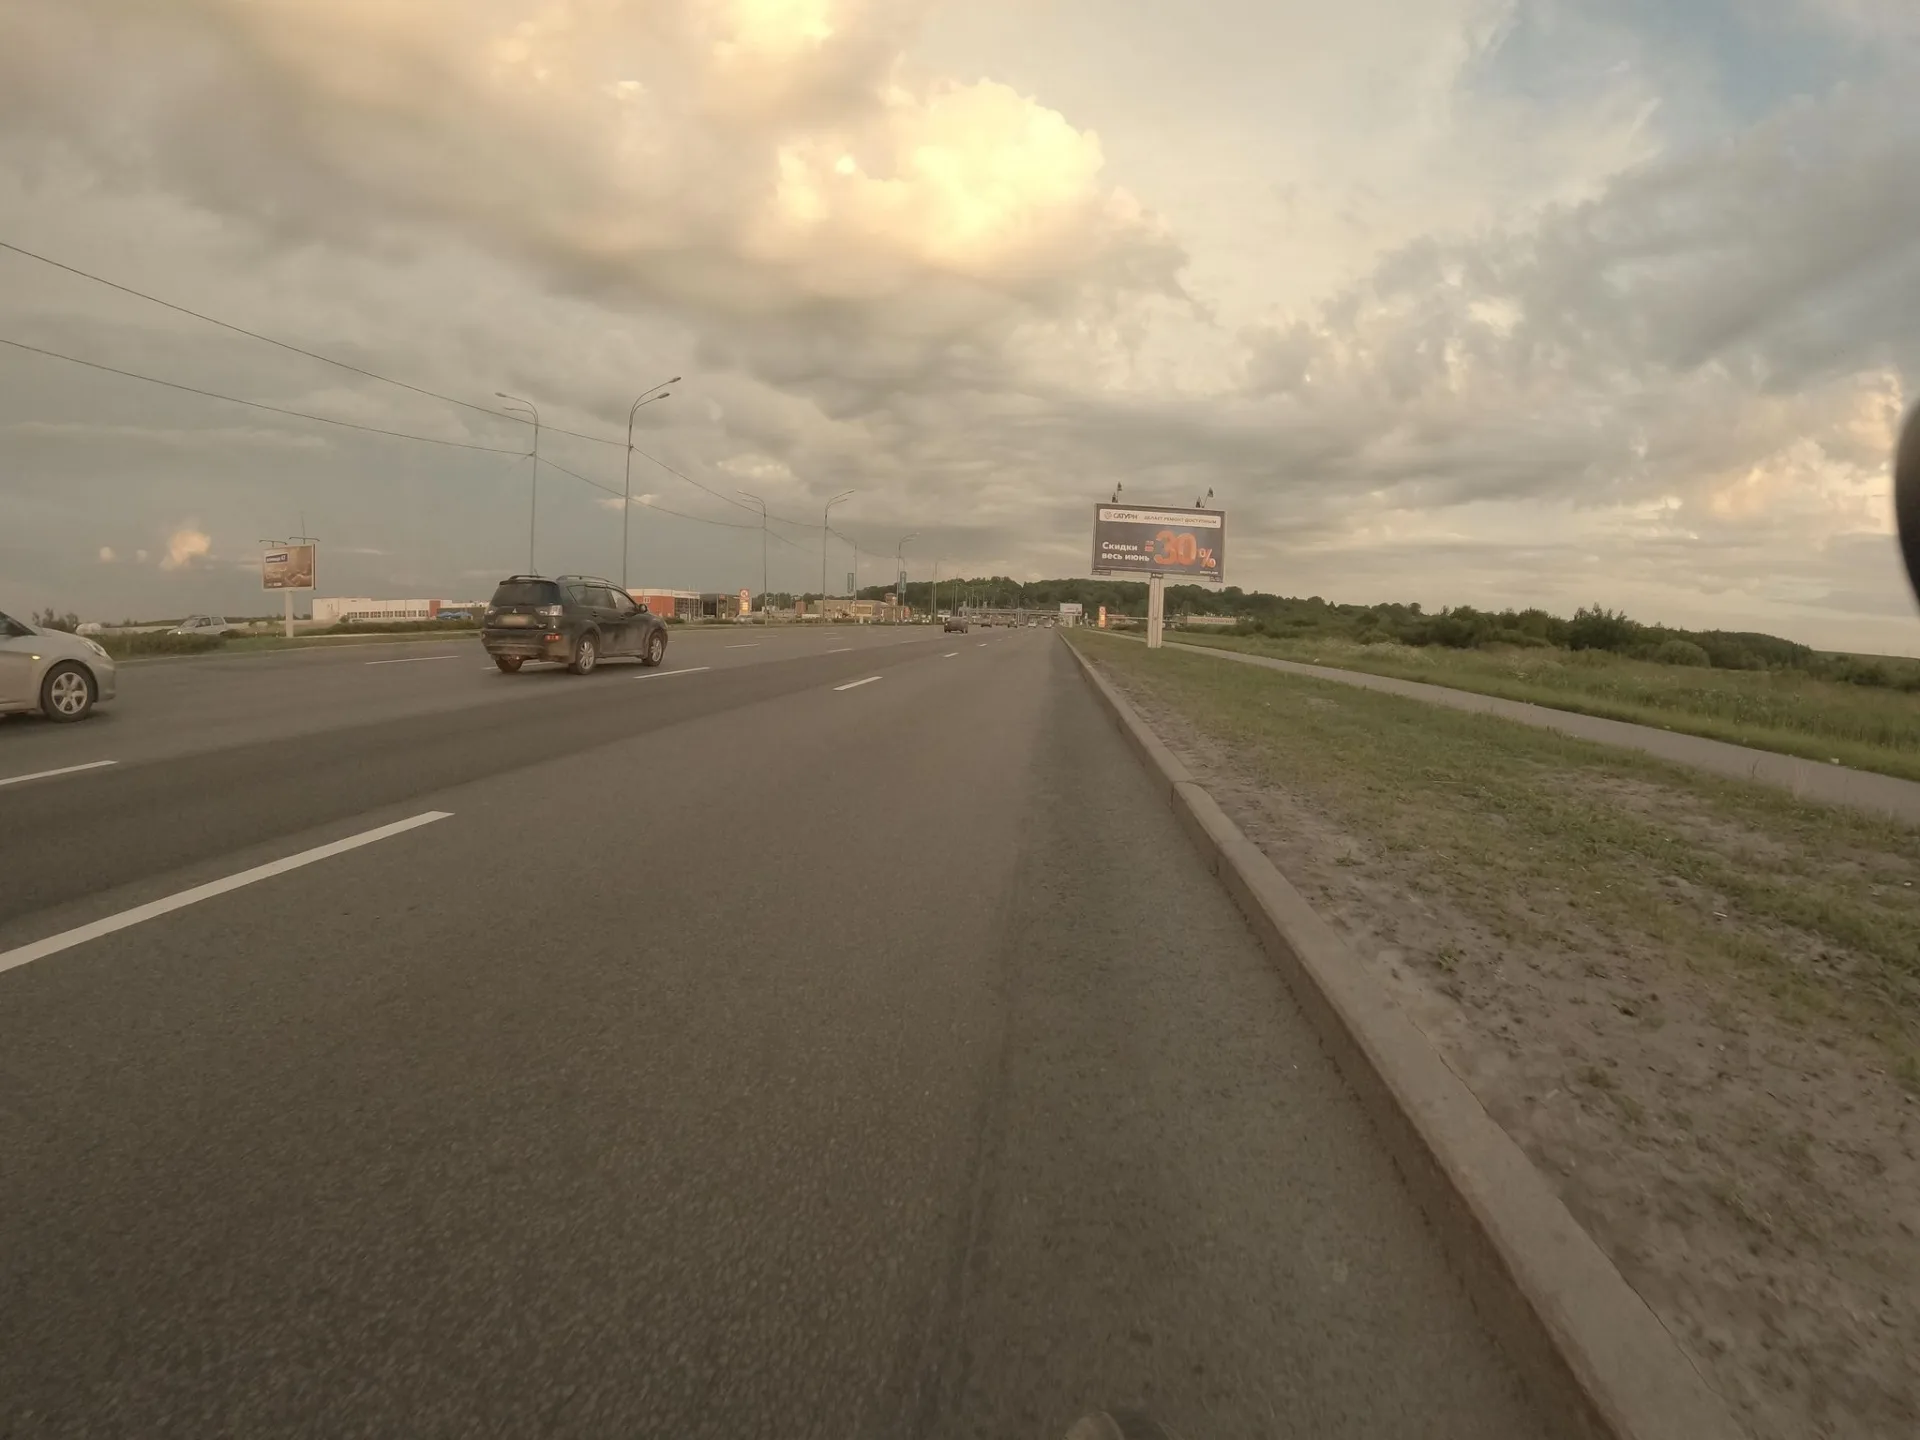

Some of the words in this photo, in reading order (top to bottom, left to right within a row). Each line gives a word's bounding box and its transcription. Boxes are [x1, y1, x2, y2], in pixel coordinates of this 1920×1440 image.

[1102, 541, 1138, 552] Скидки
[1101, 552, 1123, 561] весь
[1125, 553, 1150, 562] июнь
